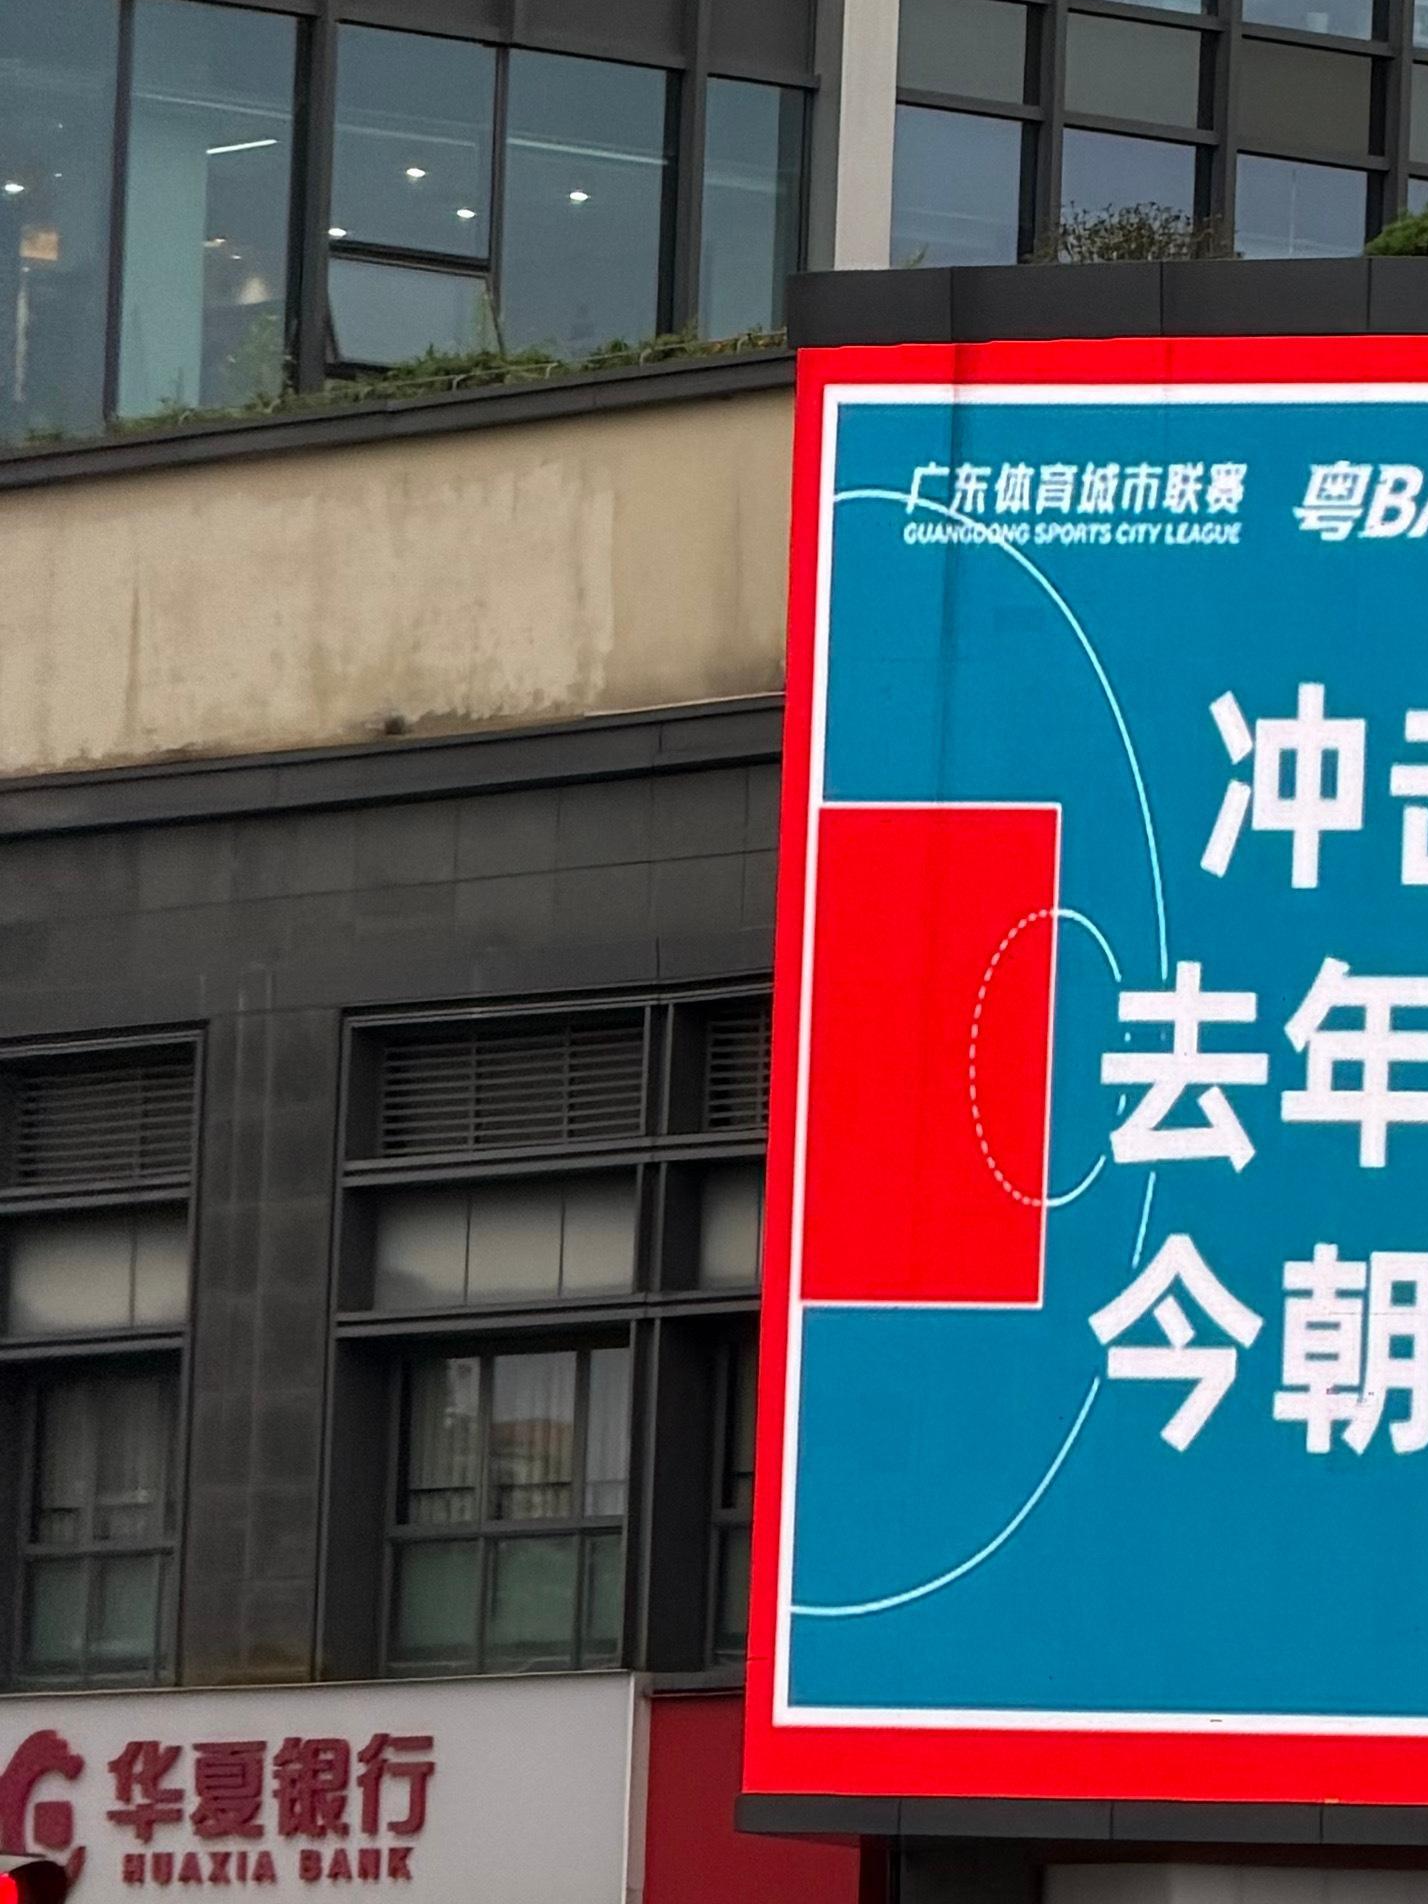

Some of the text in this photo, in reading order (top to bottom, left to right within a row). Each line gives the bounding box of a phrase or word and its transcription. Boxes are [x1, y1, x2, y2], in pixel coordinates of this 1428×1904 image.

[906, 462, 1248, 514] 广东体育城市联赛
[904, 522, 1242, 545] GUANGDONG SPORTS CITY LEAGUE
[106, 1733, 435, 1845] 华夏银行
[122, 1846, 414, 1885] HUAXIA BANK
